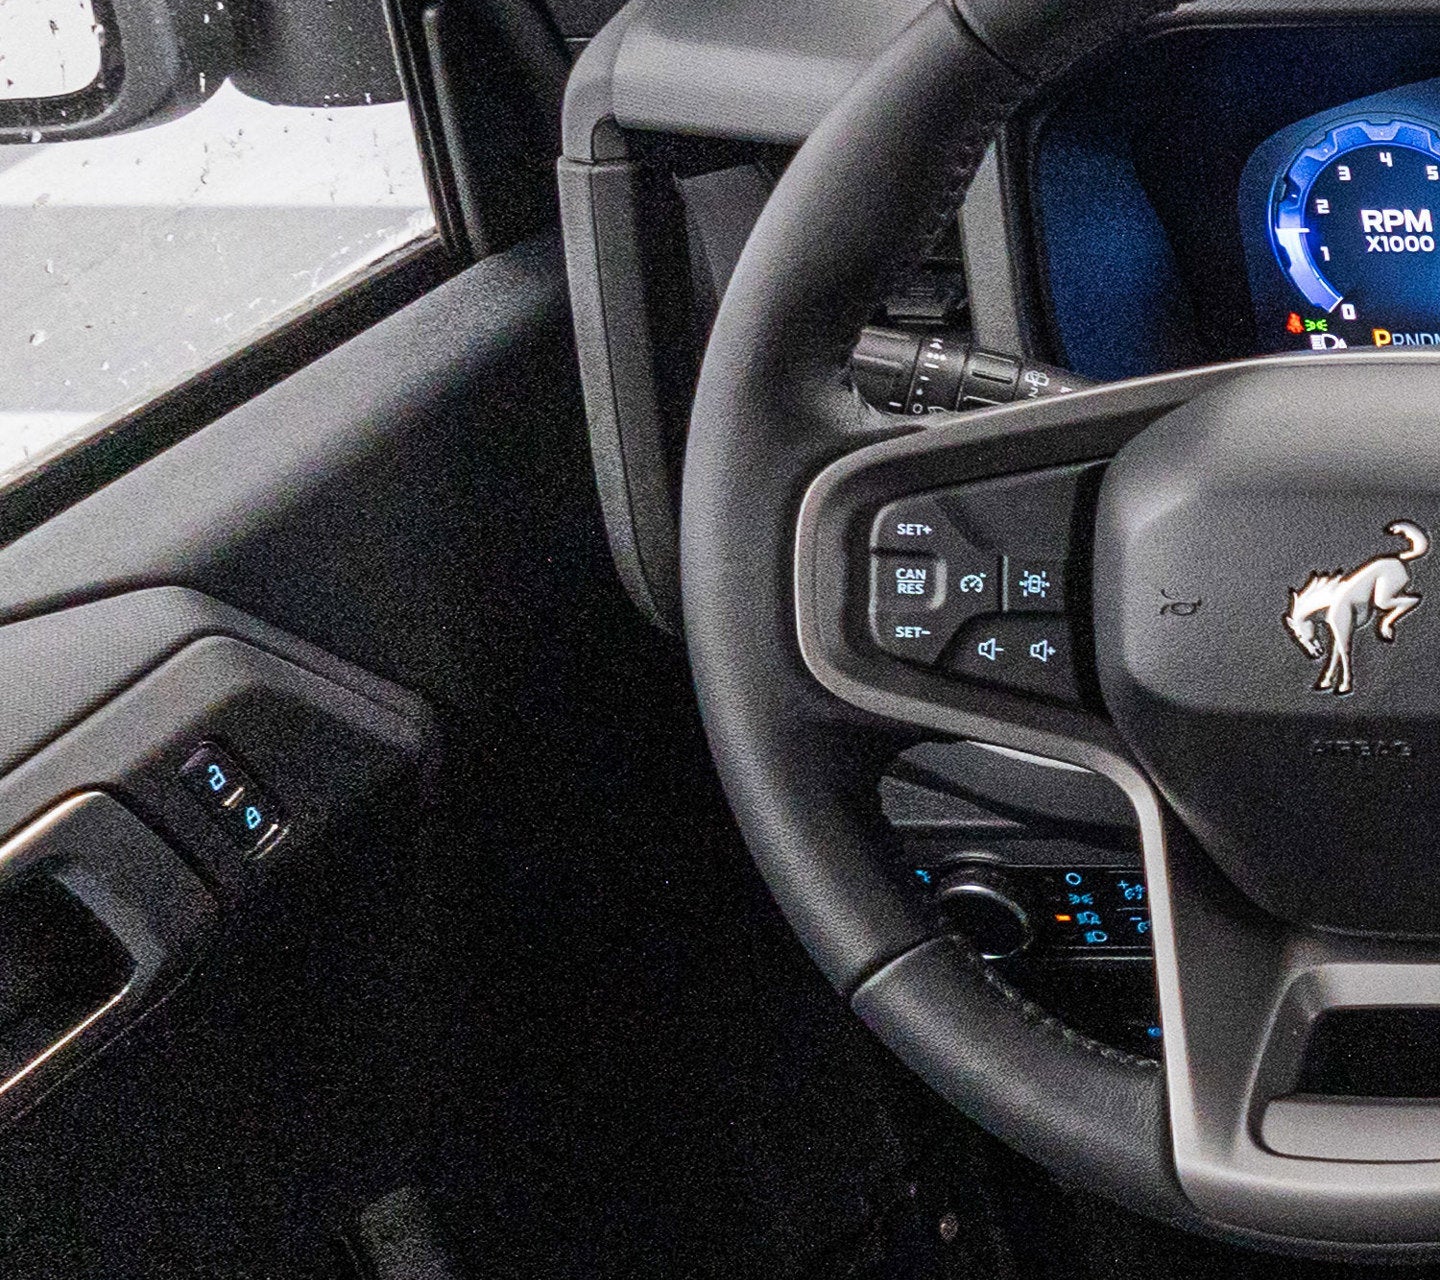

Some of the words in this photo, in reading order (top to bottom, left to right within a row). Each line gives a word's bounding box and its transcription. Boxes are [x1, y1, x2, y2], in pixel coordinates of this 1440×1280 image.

[1379, 152, 1393, 167] 4
[1338, 165, 1351, 181] 3
[1426, 165, 1440, 181] 5
[1316, 199, 1330, 214] 2
[1361, 209, 1434, 233] RPM
[1365, 235, 1436, 253] X1000
[1320, 246, 1331, 261] 1
[1340, 303, 1356, 320] 0
[897, 522, 932, 536] SET+
[895, 568, 926, 580] CAN
[897, 583, 925, 595] RES
